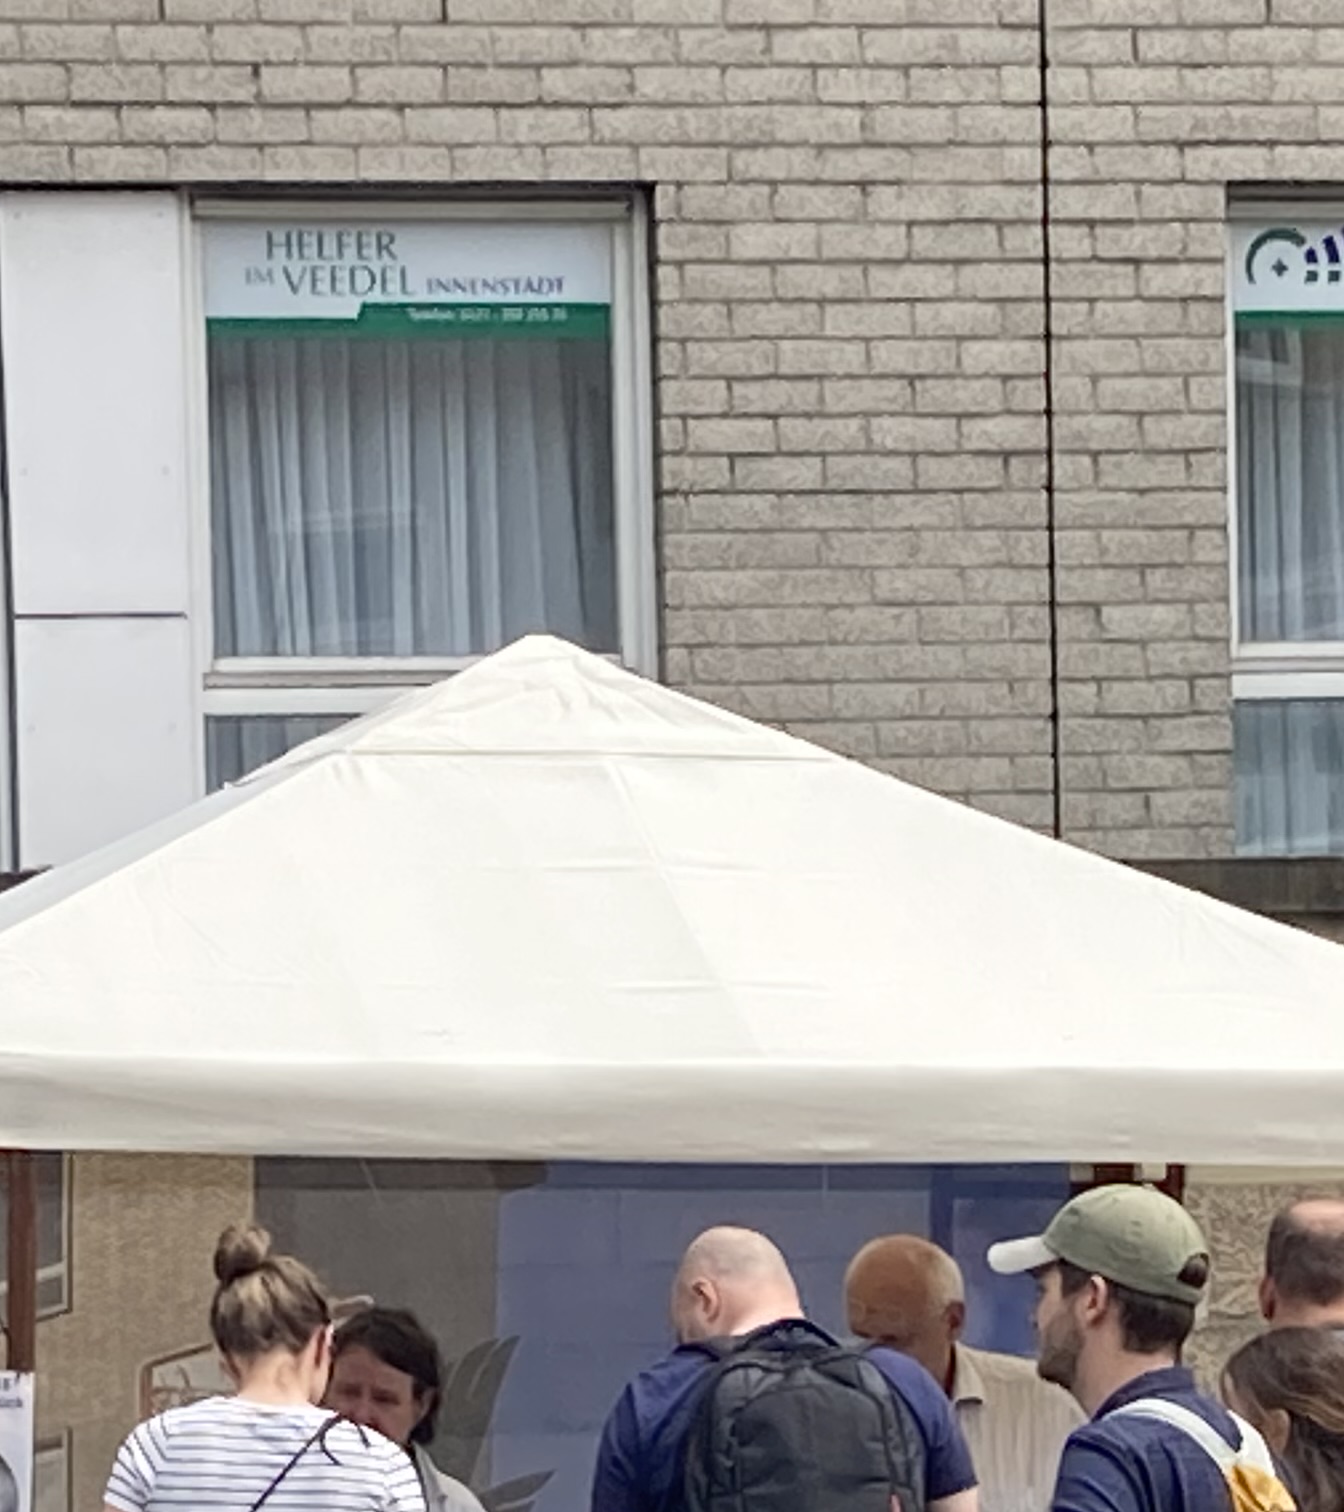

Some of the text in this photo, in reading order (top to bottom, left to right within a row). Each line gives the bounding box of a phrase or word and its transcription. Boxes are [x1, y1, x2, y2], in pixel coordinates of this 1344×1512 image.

[265, 230, 398, 262] HELFER
[244, 264, 566, 297] IM VEEDEL INNENSTADT
